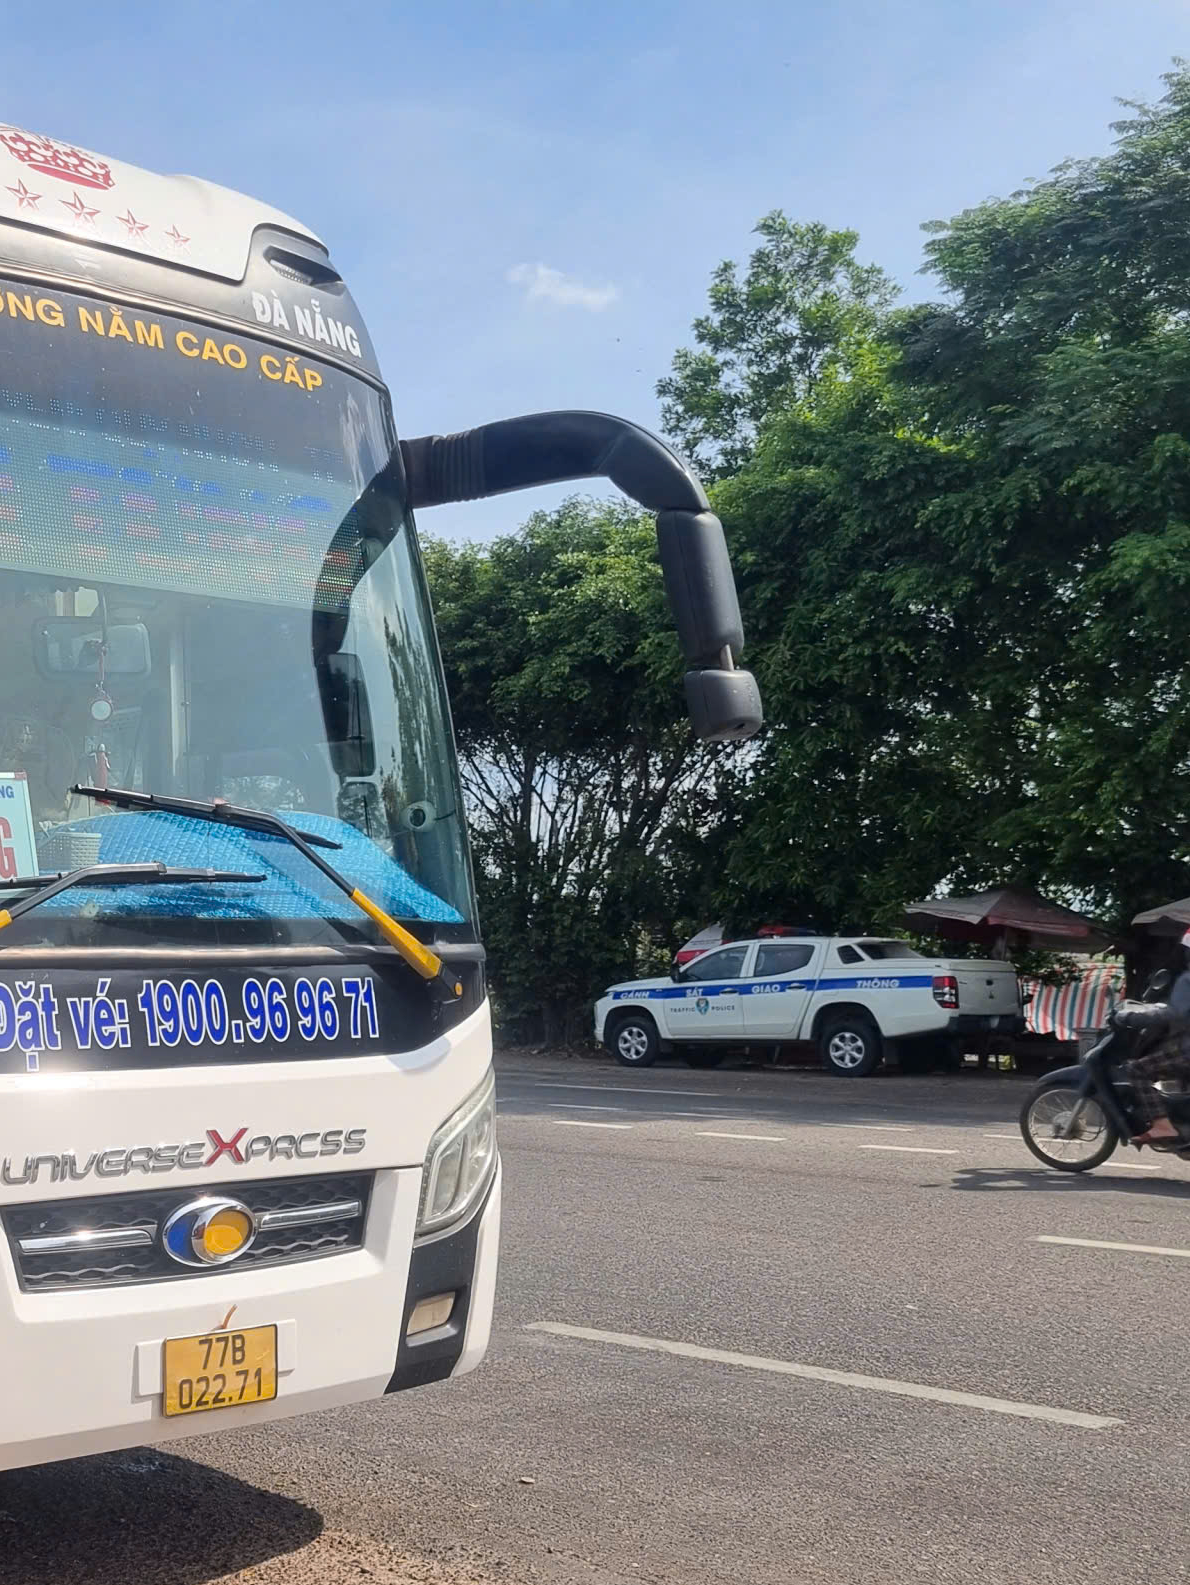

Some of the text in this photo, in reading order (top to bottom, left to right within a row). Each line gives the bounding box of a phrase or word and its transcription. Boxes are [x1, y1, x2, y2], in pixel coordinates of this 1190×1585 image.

[251, 290, 290, 332] ĐÀ
[78, 305, 165, 350] NẰM
[175, 331, 248, 369] CAO
[260, 355, 323, 391] CẤP
[751, 984, 780, 994] GIAO
[66, 977, 132, 1049] vé:
[137, 977, 290, 1047] 1900.96
[295, 976, 338, 1041] 96
[341, 976, 380, 1039] 71
[198, 1334, 246, 1370] 77B
[178, 1367, 263, 1410] 022.71
